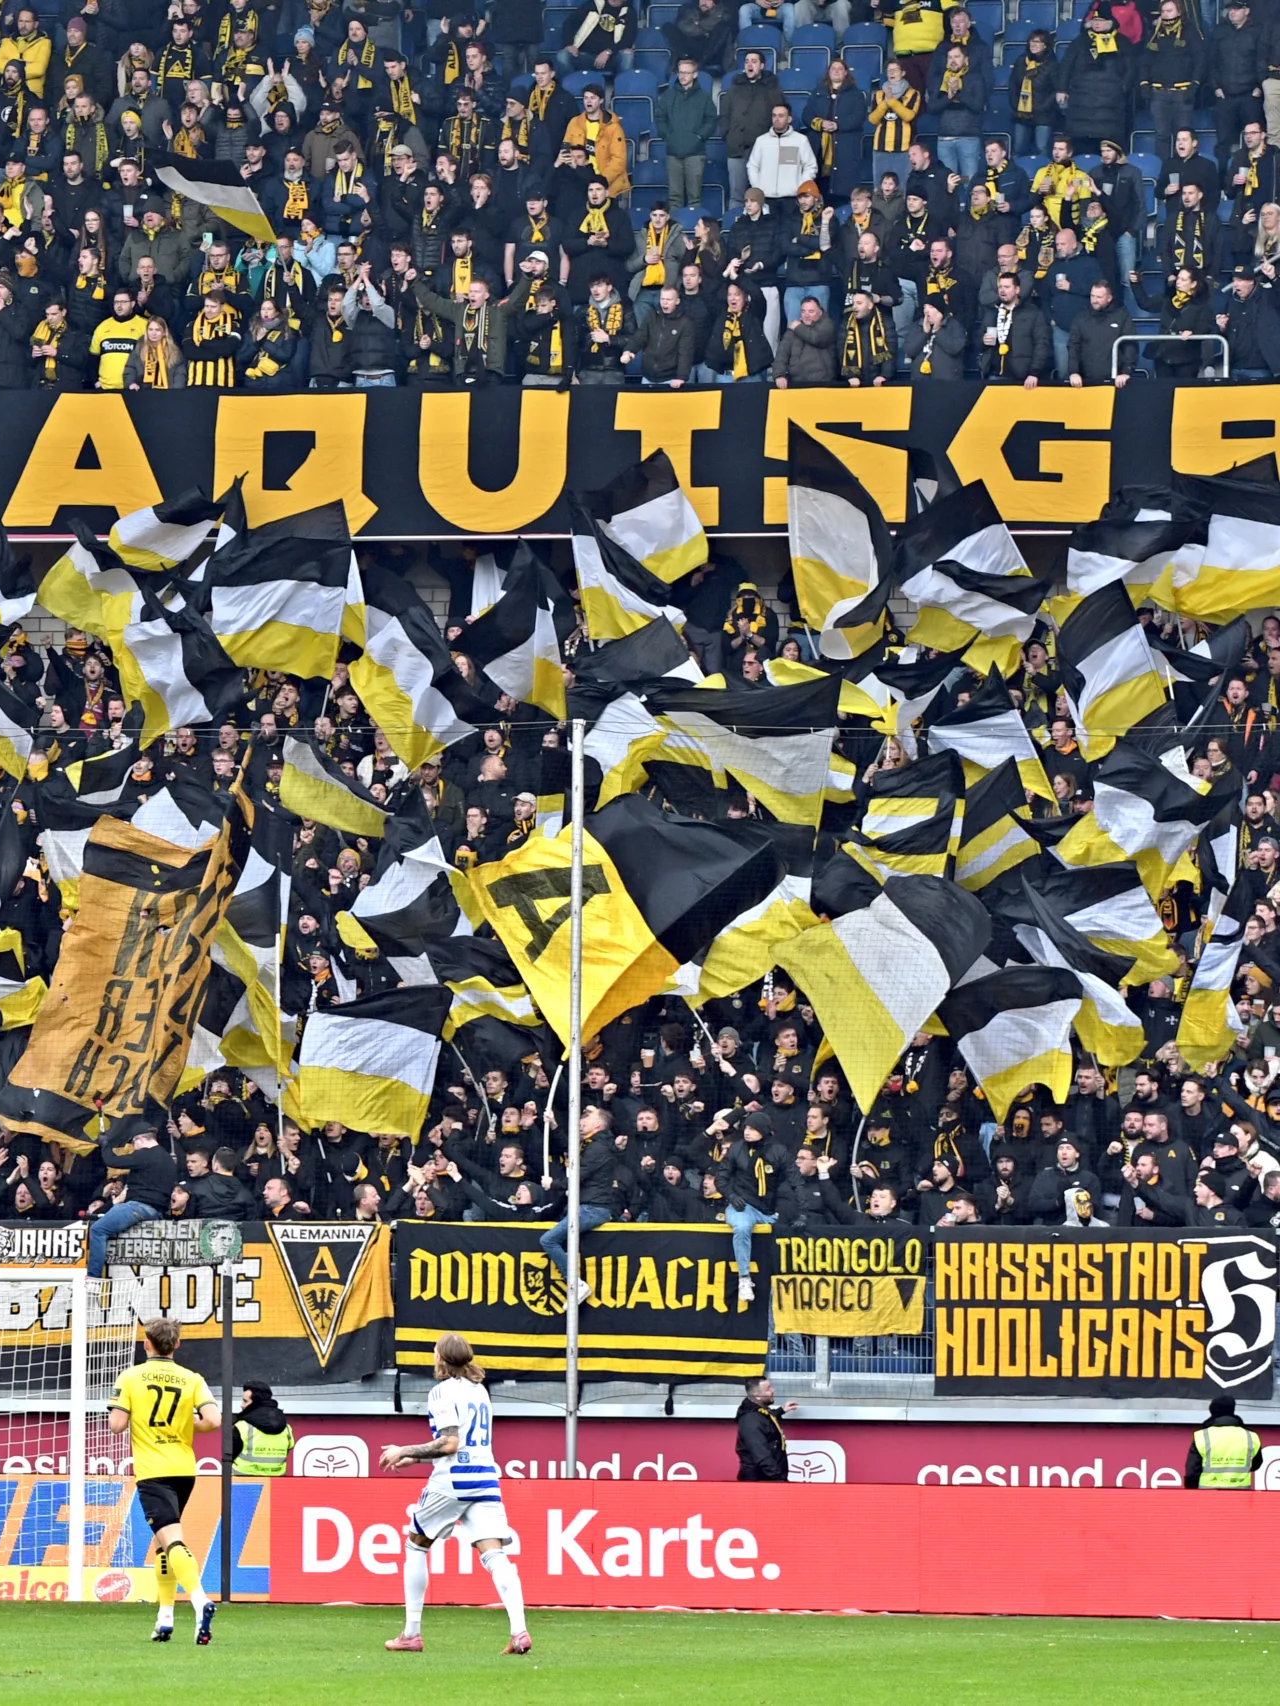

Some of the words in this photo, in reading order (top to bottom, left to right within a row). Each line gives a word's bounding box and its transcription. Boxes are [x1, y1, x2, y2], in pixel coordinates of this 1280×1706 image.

[11, 1228, 85, 1258] JAHRE
[106, 1239, 172, 1259] STERBEN
[174, 1240, 200, 1259] NIE!
[280, 1227, 367, 1241] ALEMANNIA
[308, 1246, 341, 1280] A
[776, 1237, 922, 1275] TRIANGOLO
[935, 1241, 1208, 1302] KAISERSTADT
[409, 1247, 519, 1307] DOM
[776, 1277, 873, 1312] MAGICO
[935, 1307, 1206, 1380] HOOLIGANS
[141, 1373, 187, 1386] SCHROERS
[146, 1384, 182, 1427] 27
[466, 1402, 490, 1447] 29
[917, 1457, 1182, 1489] gesundde
[547, 1508, 781, 1580] Karte.
